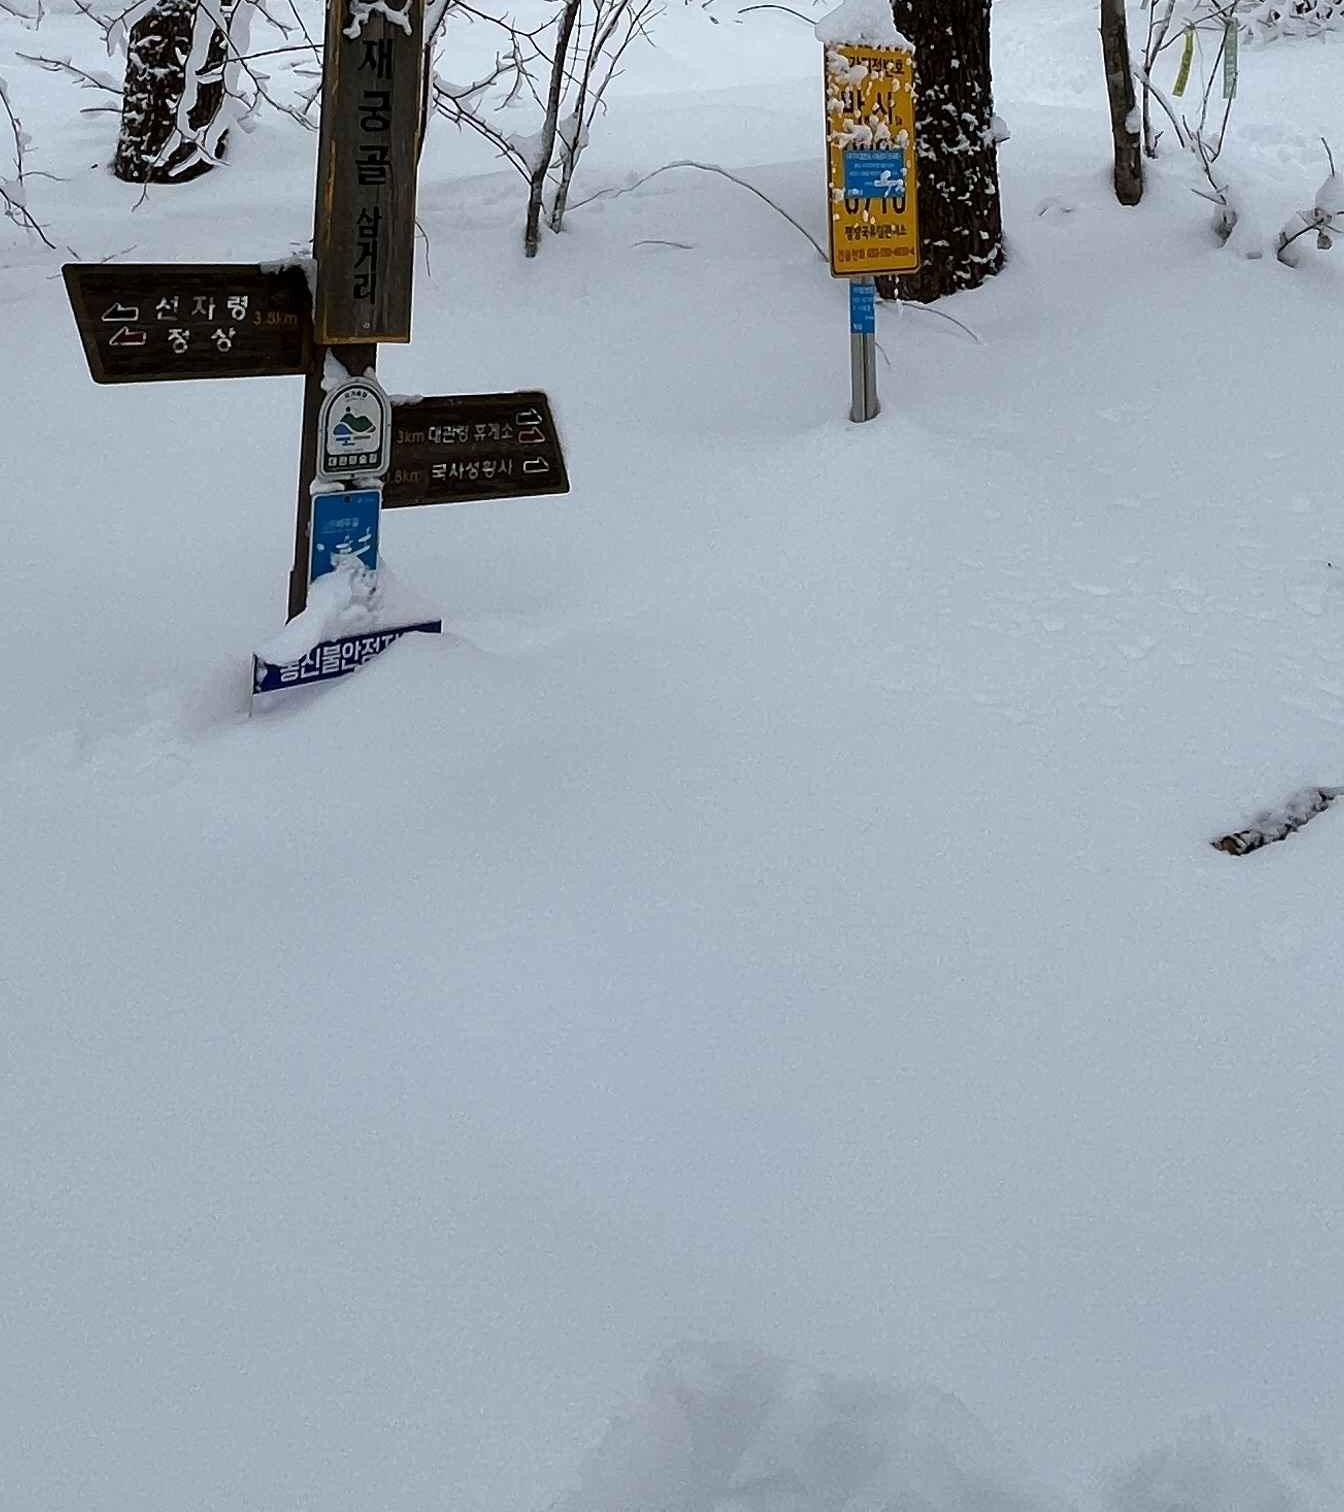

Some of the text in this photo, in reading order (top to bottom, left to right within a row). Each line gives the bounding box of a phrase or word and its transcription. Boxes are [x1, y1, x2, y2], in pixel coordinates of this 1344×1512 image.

[352, 38, 394, 305] 재궁골 삼거리
[155, 295, 249, 321] 선자령
[167, 327, 236, 354] 정상
[428, 423, 469, 444] 대관령
[474, 422, 513, 441] 휴게소
